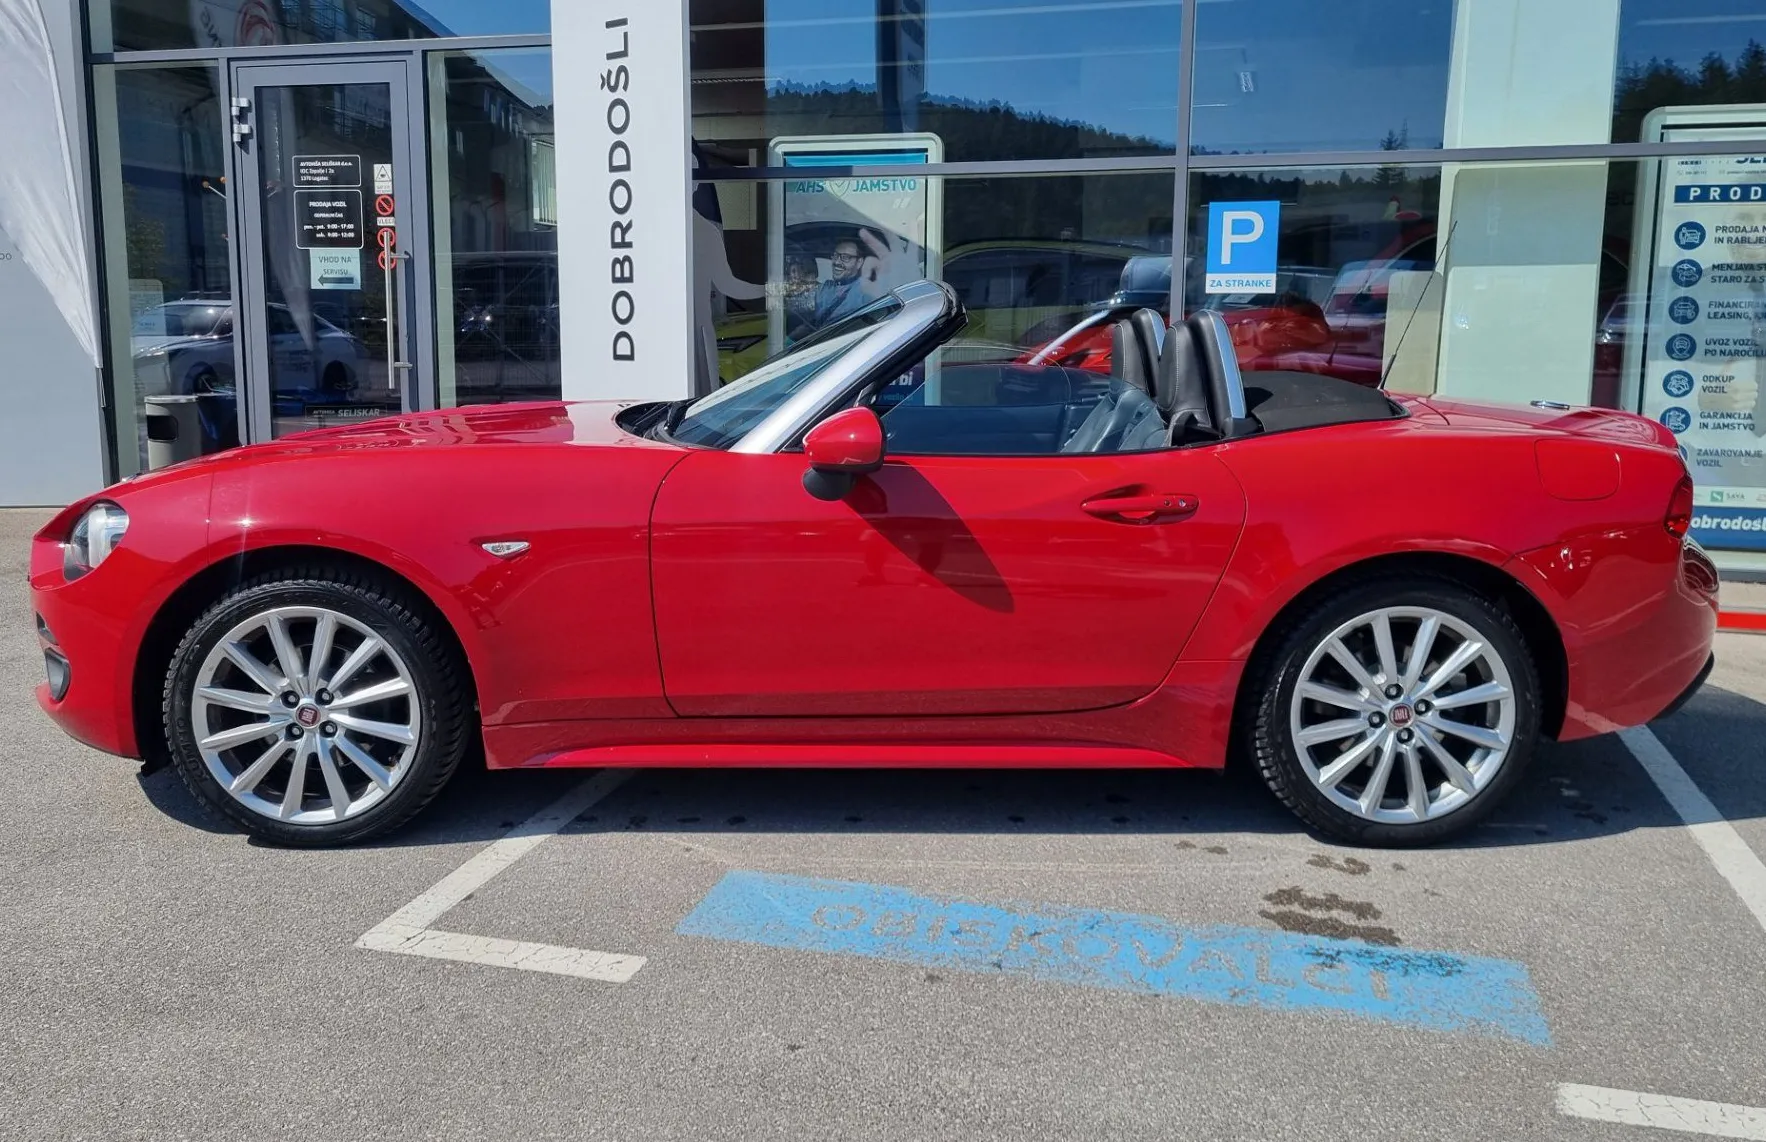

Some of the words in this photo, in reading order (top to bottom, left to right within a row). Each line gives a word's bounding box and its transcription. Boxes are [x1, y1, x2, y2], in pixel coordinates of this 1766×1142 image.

[600, 17, 635, 362] DOBRODOŠLI
[796, 180, 825, 193] AHS
[852, 179, 917, 192] JAMSTVO
[1715, 225, 1759, 233] PRODAJA
[1221, 211, 1264, 265] P
[1714, 236, 1724, 244] IN
[1727, 236, 1766, 244] RABLJE
[1711, 263, 1755, 271] MENJAVA
[323, 268, 349, 276] SERVISU
[1711, 275, 1742, 283] STARO
[1744, 275, 1757, 283] ZA
[1705, 338, 1730, 346] UVOZ
[1704, 349, 1717, 357] PO
[1702, 375, 1734, 383] ODKUP
[1700, 411, 1753, 420] GARANCIJA
[1699, 422, 1709, 430] IN
[1711, 422, 1756, 431] JAMSTVO
[1696, 448, 1763, 458] ZAVAROVANJE
[1696, 459, 1722, 467] VOZIL
